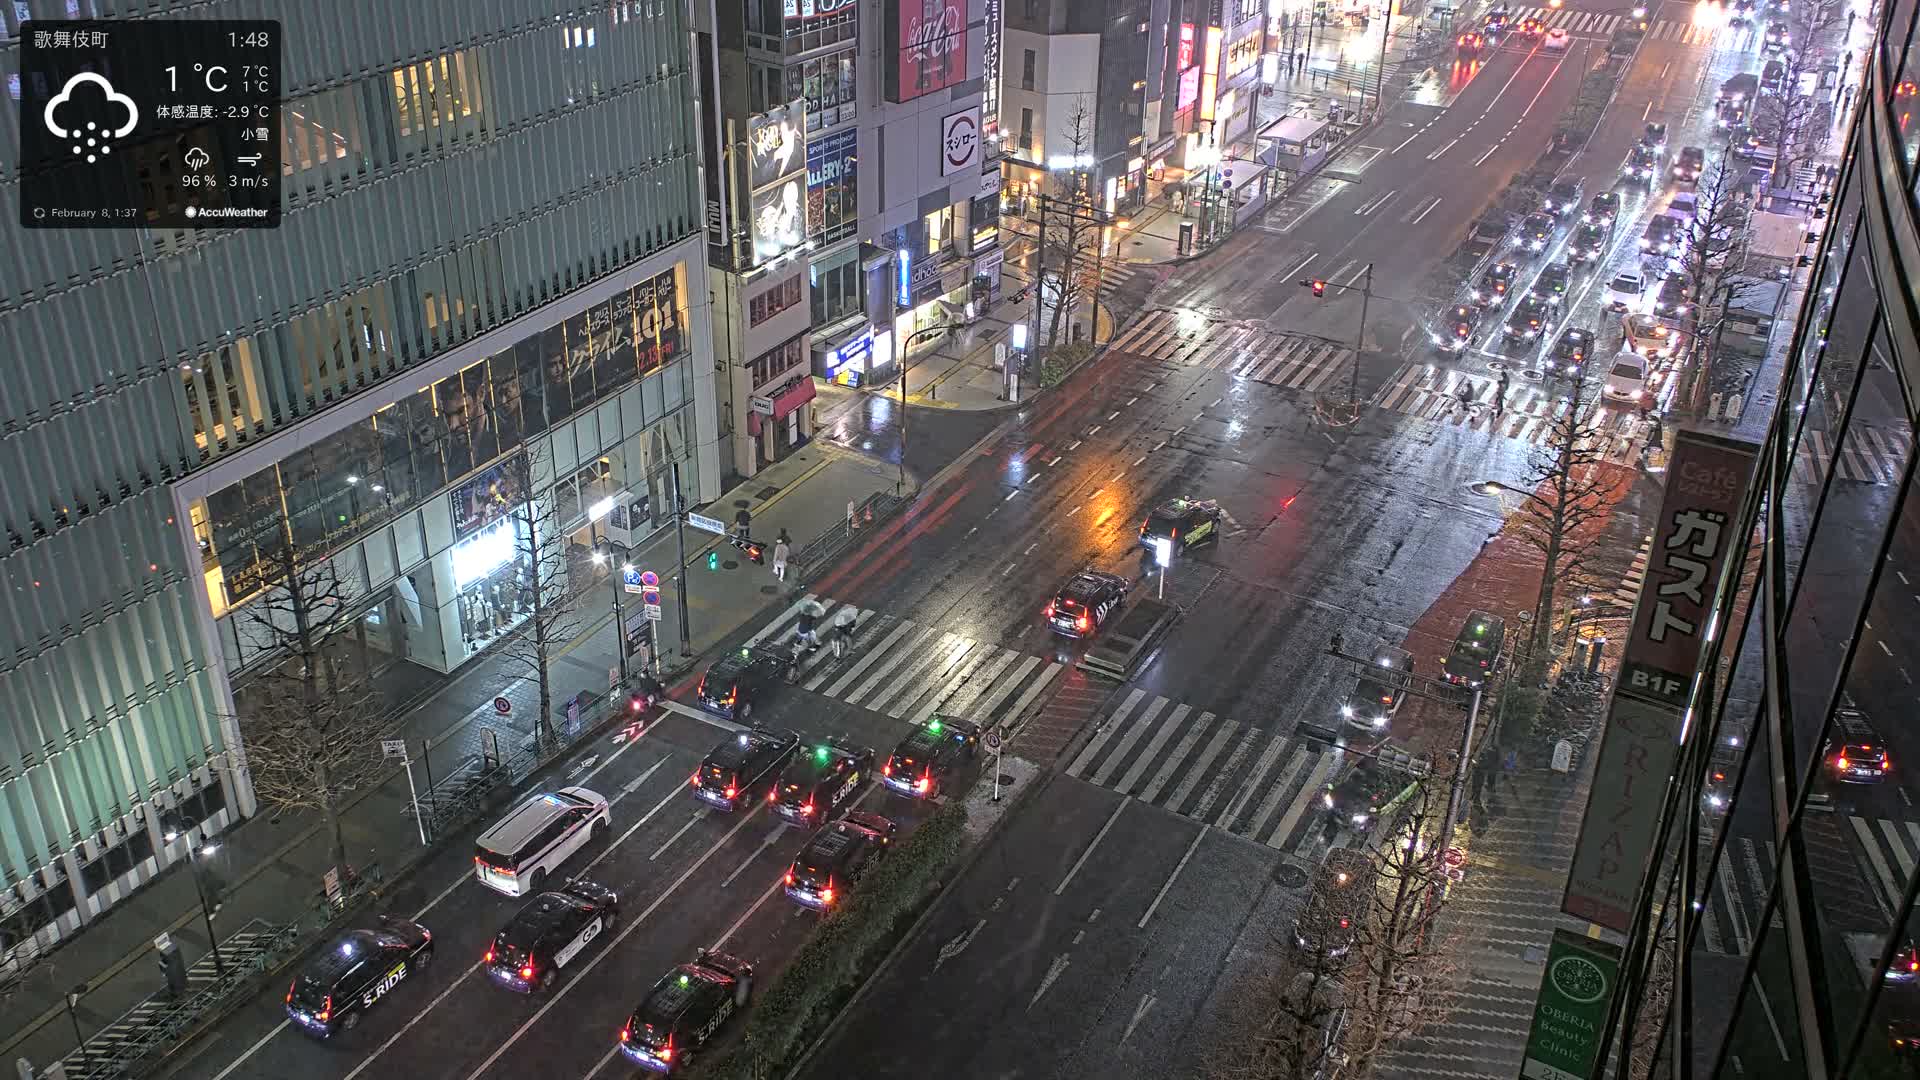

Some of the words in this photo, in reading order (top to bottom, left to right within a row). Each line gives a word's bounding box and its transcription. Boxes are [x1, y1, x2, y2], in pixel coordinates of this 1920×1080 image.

[946, 133, 977, 151] スシロー
[708, 200, 721, 233] MUJI
[1649, 510, 1726, 641] ガスト
[1631, 669, 1681, 695] B1F
[1541, 1005, 1594, 1032] OBERIA
[1541, 1020, 1588, 1046] Beauty
[1540, 1040, 1580, 1062] Clinic
